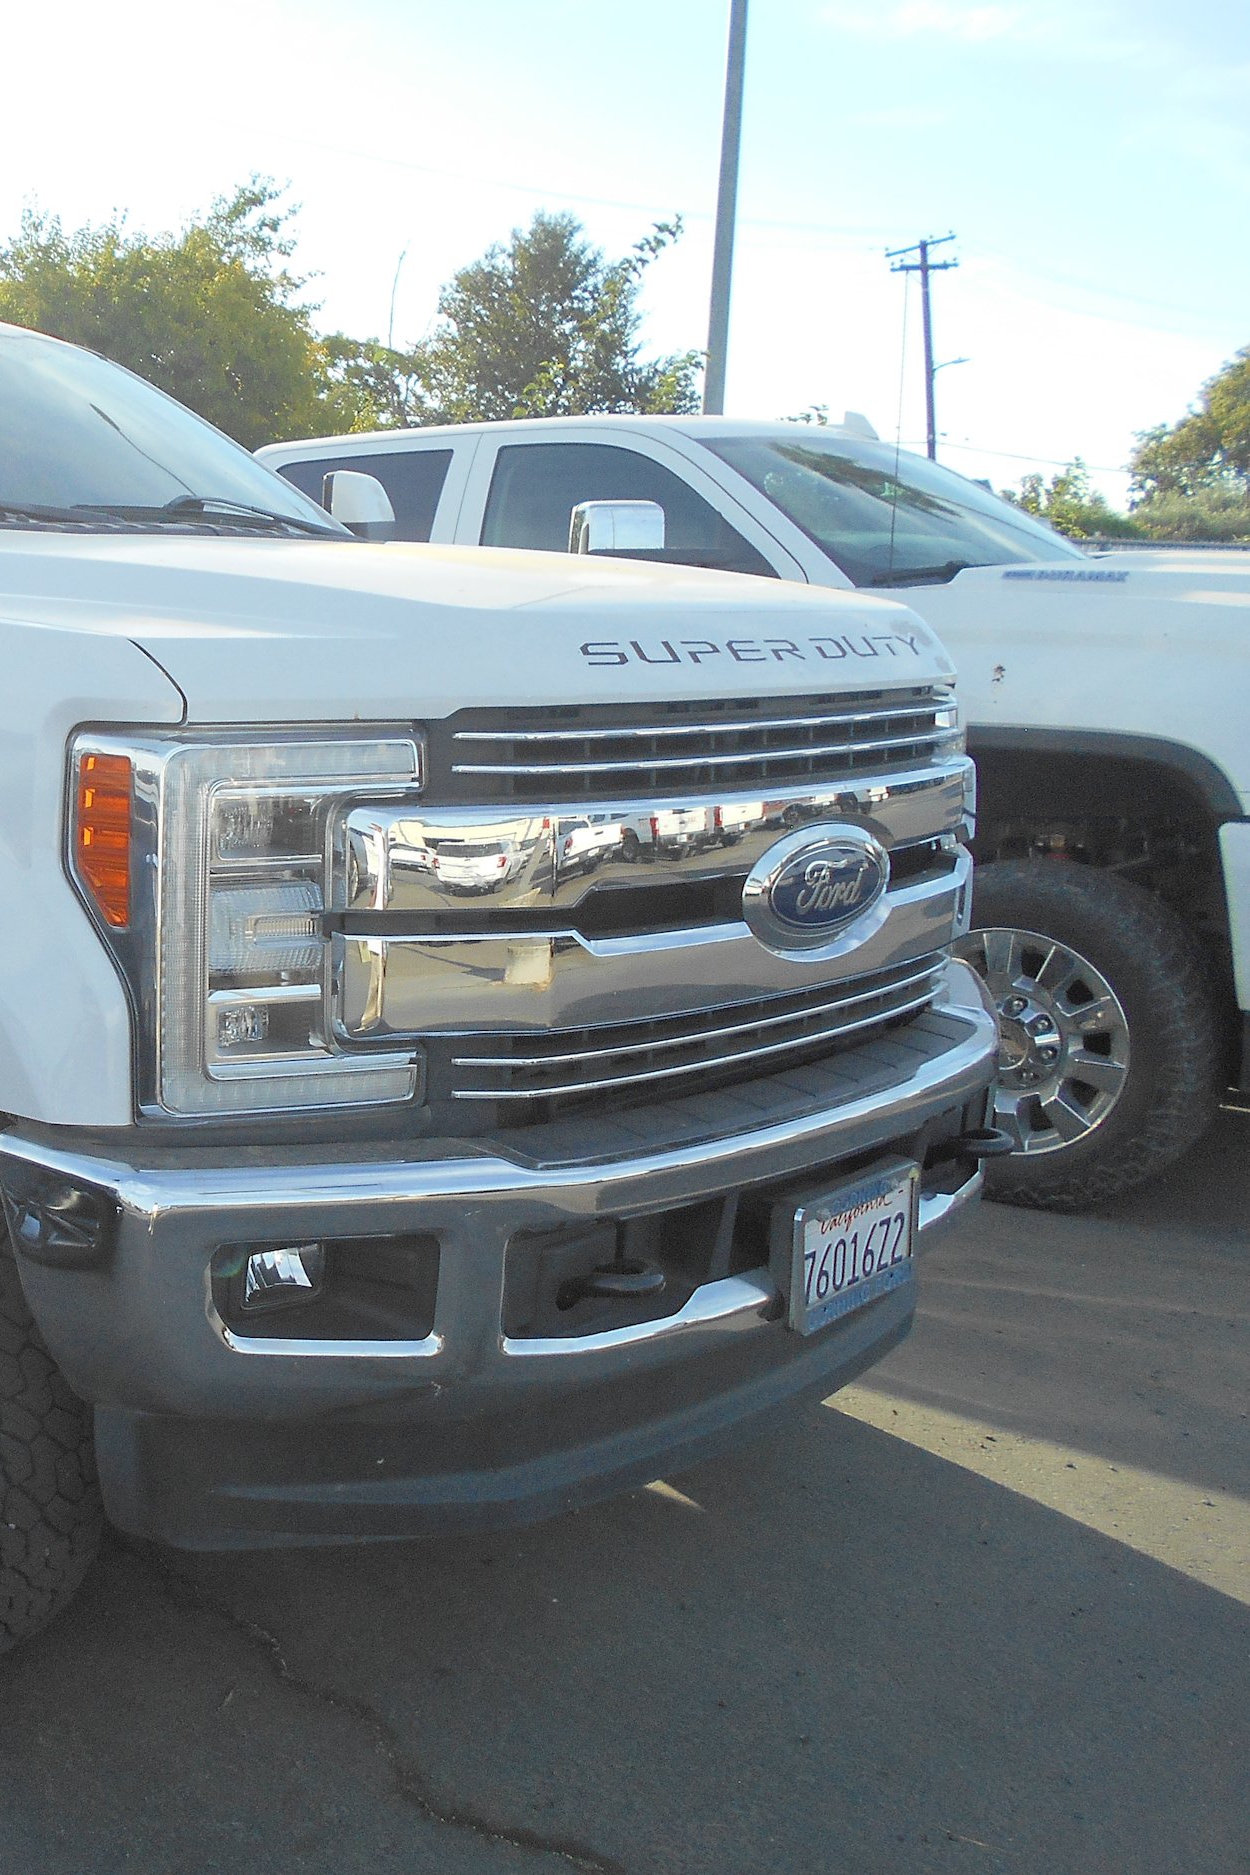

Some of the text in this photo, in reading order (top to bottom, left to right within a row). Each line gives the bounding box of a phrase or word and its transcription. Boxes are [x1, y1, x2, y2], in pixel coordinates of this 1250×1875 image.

[578, 634, 922, 667] SUPER DUTY
[796, 859, 869, 916] Ford
[804, 1211, 906, 1307] 76016Z2
